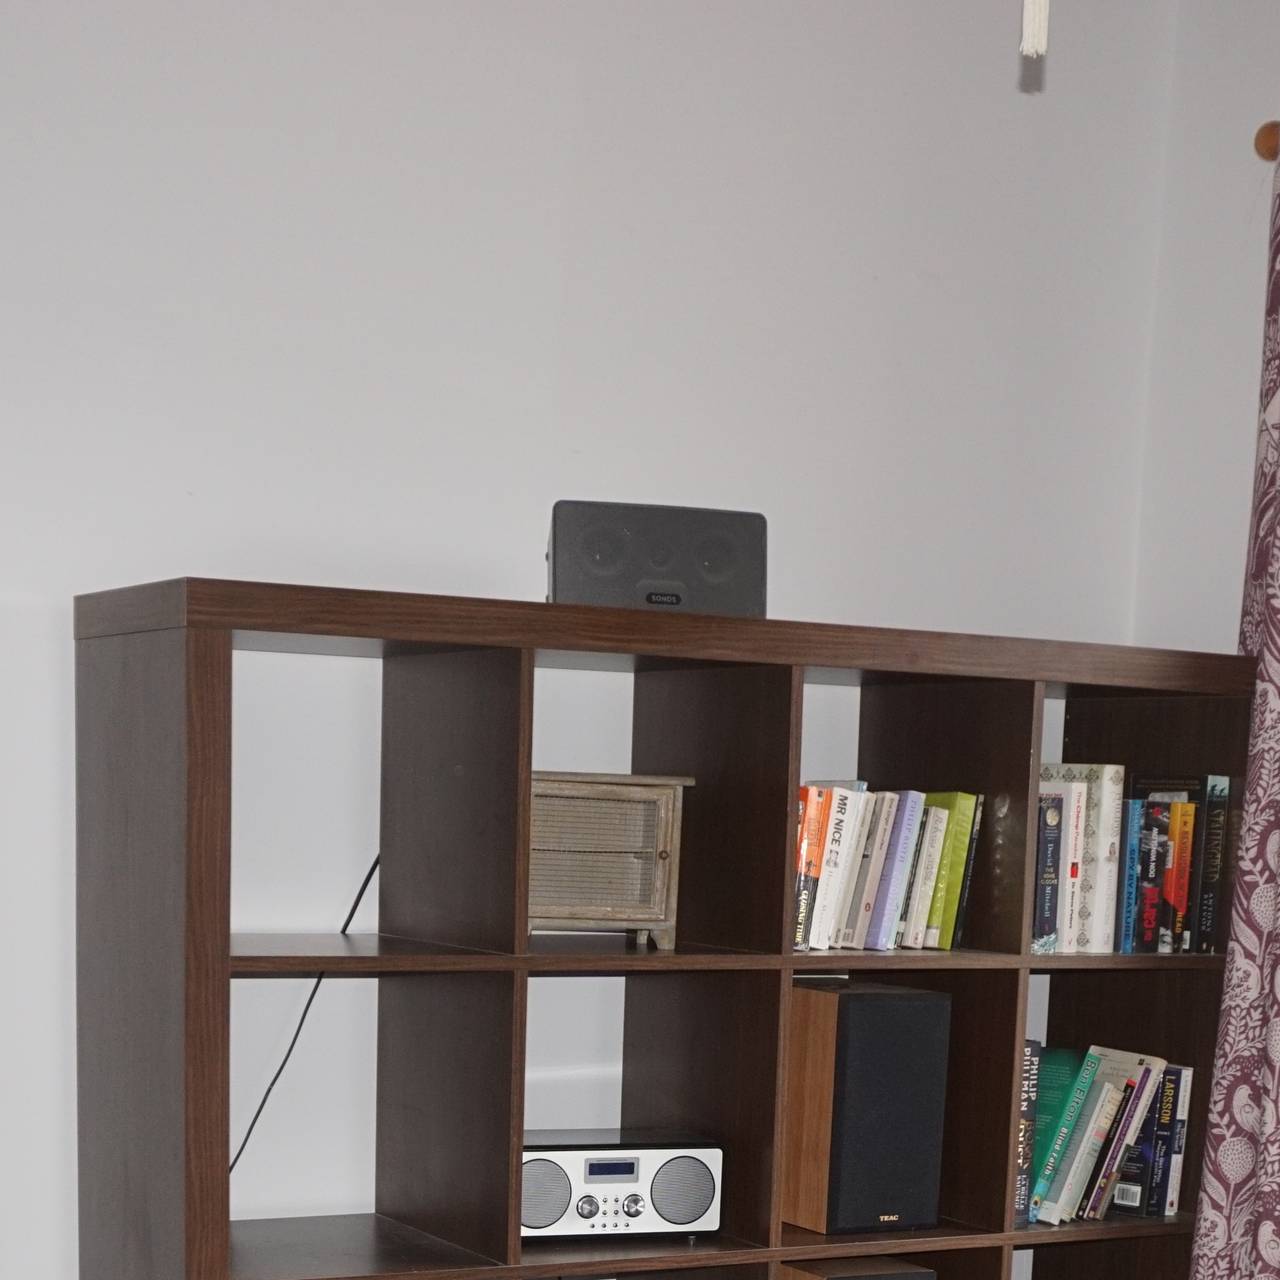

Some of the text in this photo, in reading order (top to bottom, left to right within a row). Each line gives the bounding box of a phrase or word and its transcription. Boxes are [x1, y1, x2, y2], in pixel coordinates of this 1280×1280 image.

[651, 595, 676, 604] SONOS
[830, 794, 849, 847] MR NICE
[1046, 843, 1055, 866] David
[1205, 809, 1225, 882] STALINGRAD
[1147, 862, 1156, 878] DON
[1044, 885, 1054, 917] Mitchell
[1124, 848, 1137, 941] SPY BY NATURE
[794, 924, 804, 944] TIME
[1030, 1056, 1040, 1101] PHILIP
[1064, 1086, 1086, 1122] Elton
[1161, 1075, 1175, 1123] LARSSON
[879, 1214, 899, 1222] TEAC
